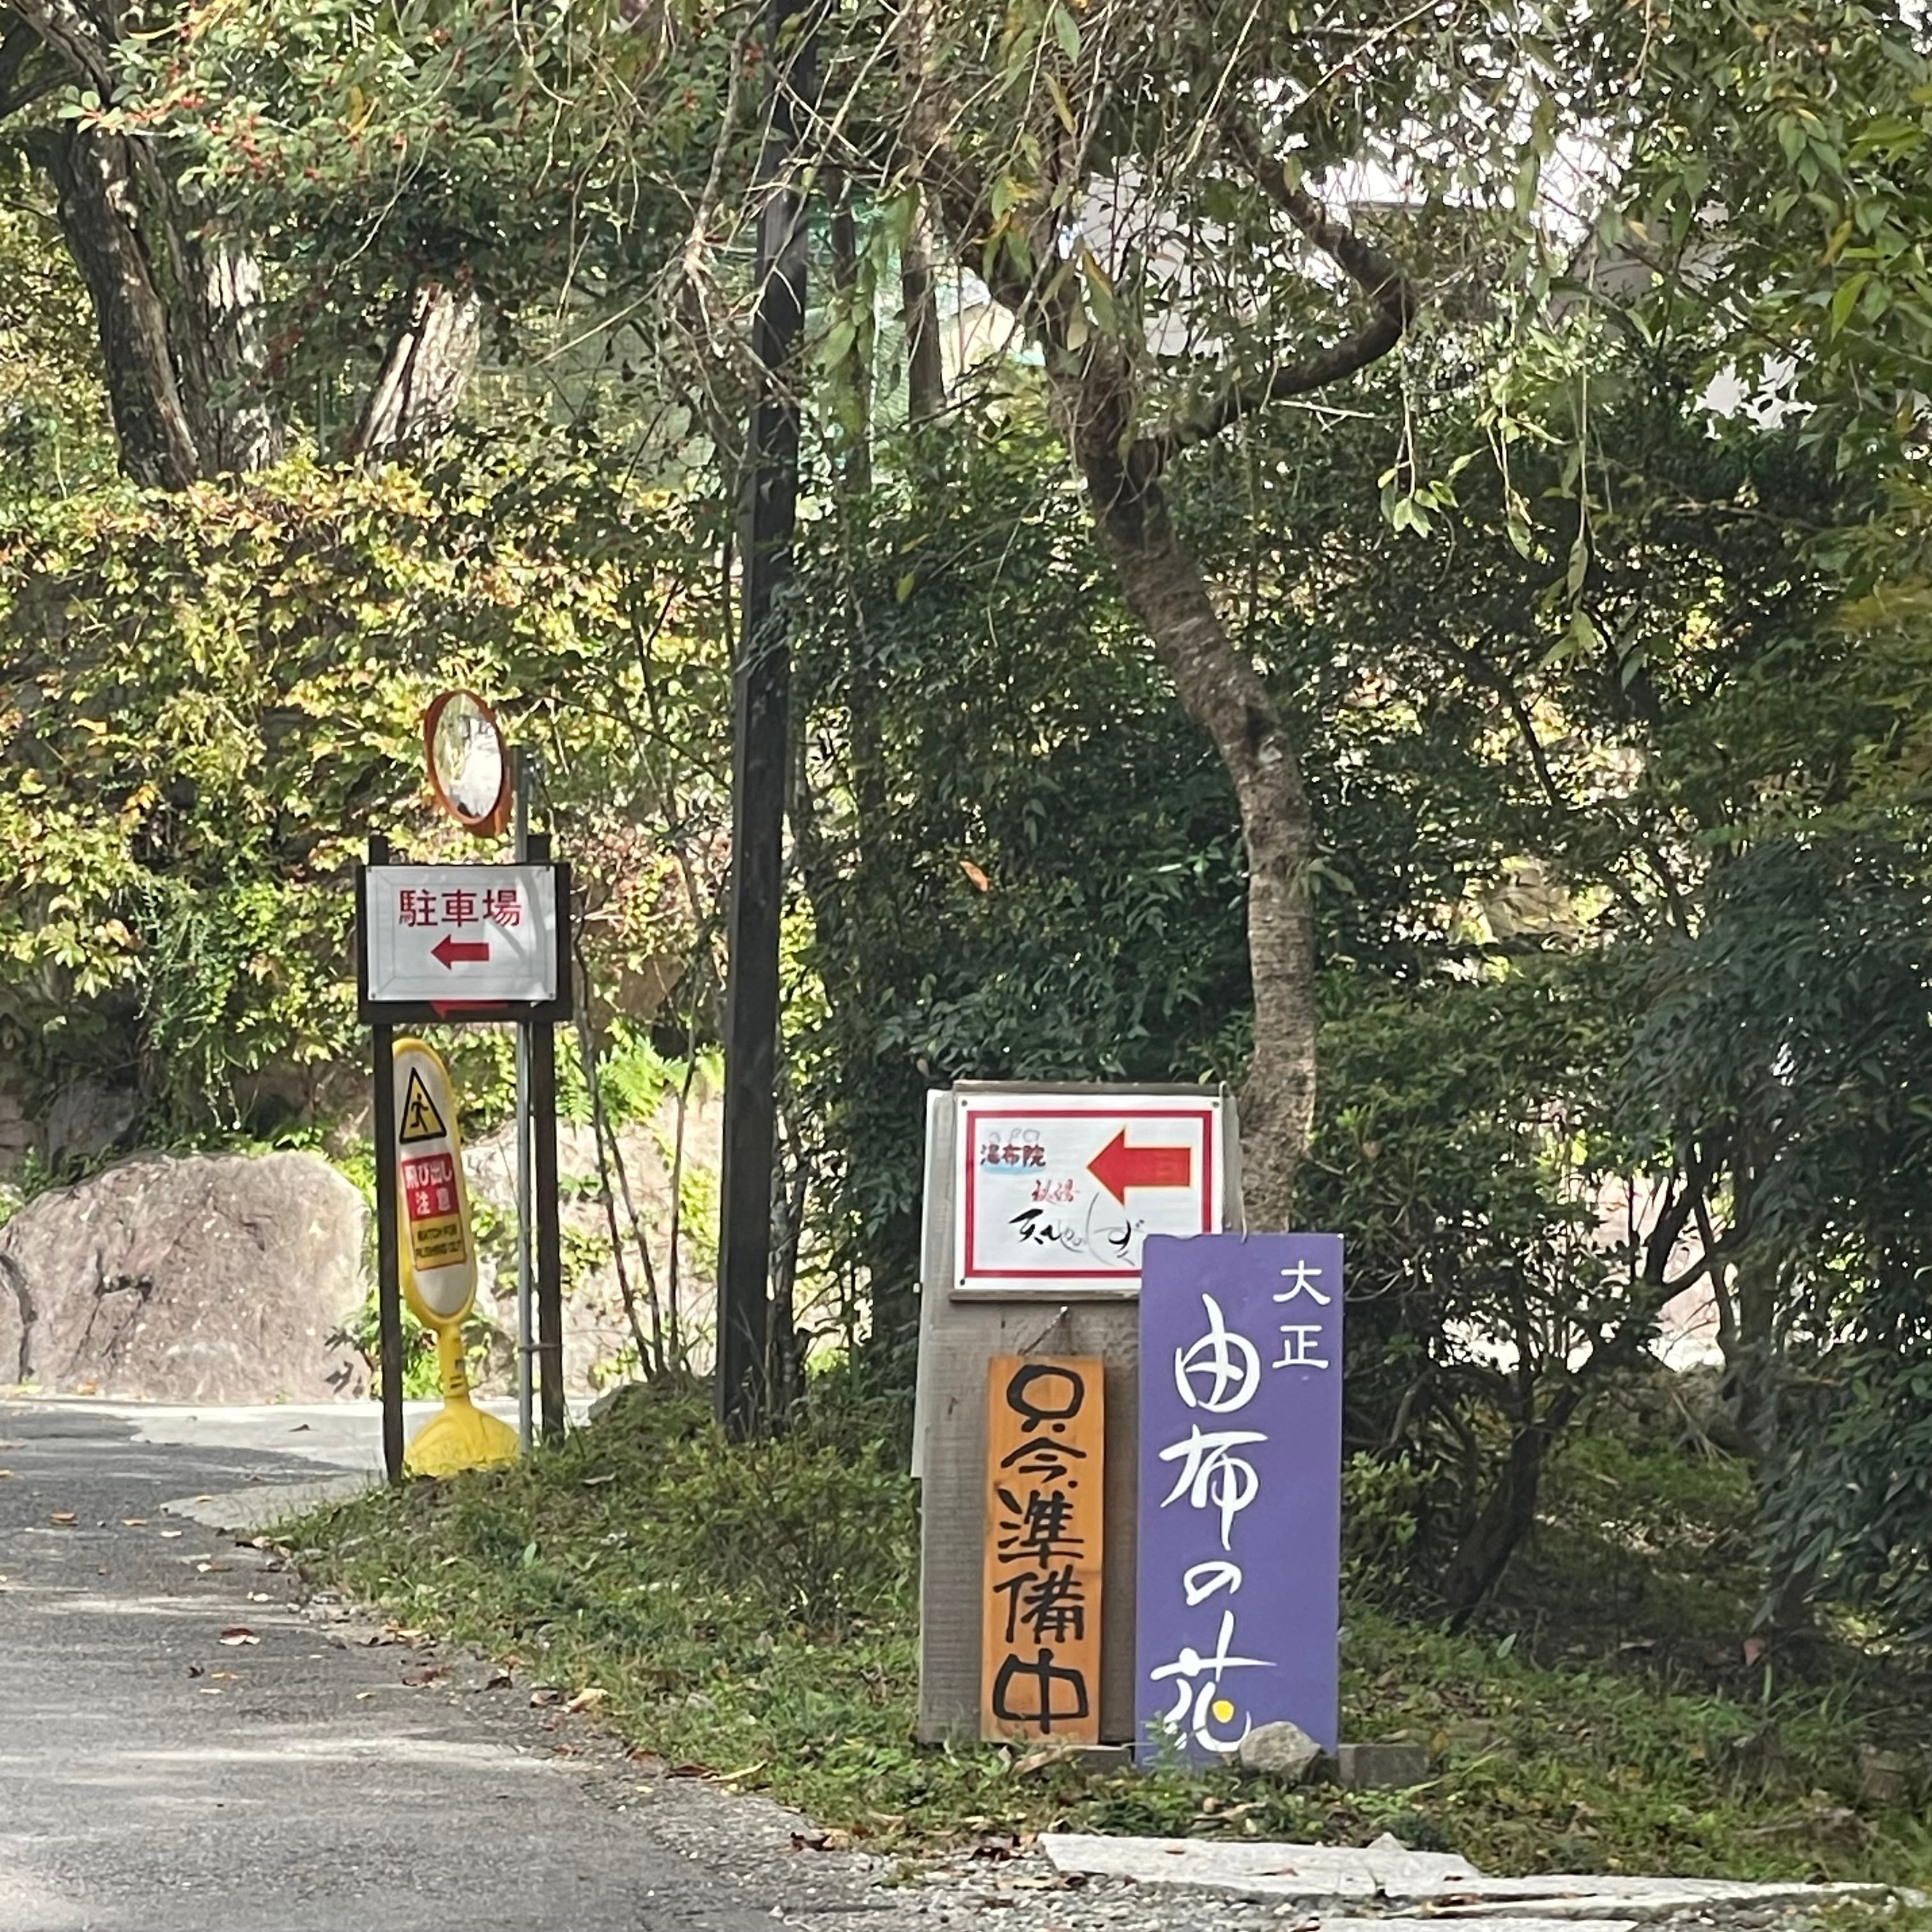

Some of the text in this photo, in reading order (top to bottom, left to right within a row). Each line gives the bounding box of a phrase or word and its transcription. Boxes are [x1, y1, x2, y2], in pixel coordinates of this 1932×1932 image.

[398, 889, 522, 928] 駐車場
[1272, 1259, 1331, 1370] 大正
[992, 1364, 1089, 1734] 只今準備中
[1149, 1293, 1277, 1752] 由布の花
